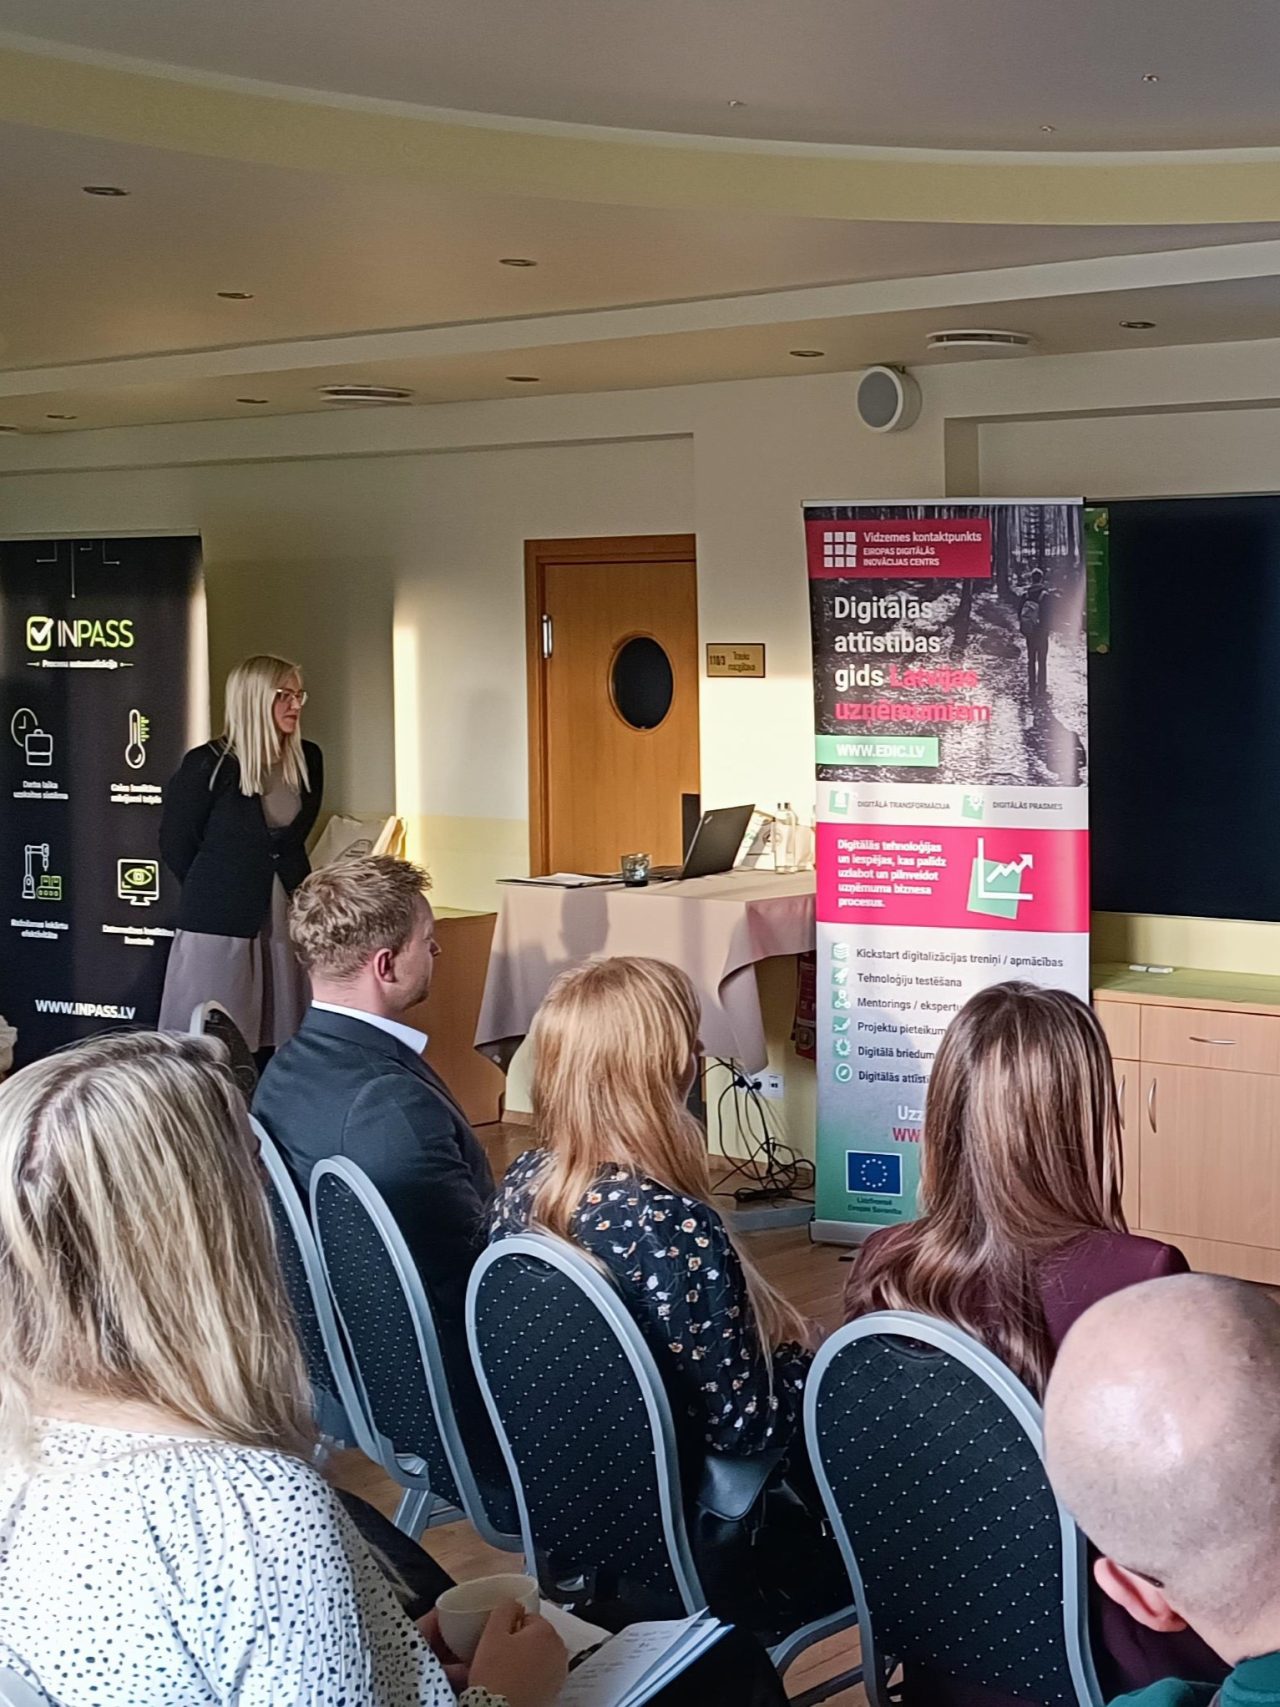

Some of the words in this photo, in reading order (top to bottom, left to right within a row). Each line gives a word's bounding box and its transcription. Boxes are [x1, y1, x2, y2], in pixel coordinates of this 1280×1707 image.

[863, 532, 911, 542] Vidzemes
[913, 531, 982, 544] kontaktpunkts
[863, 547, 895, 556] EIROPAS
[910, 558, 940, 567] CENTRS
[834, 596, 933, 623] Digitālās
[58, 619, 134, 648] INPASS
[834, 632, 941, 653] attīstības
[835, 664, 884, 691] gids
[889, 665, 980, 692] Latvijas
[835, 700, 992, 727] uzņēmumiem
[836, 743, 925, 758] WWW.EDIC.LV
[857, 948, 900, 960] Kickstart
[902, 950, 968, 965] digitalizācijas
[970, 954, 1001, 967] treniņi
[1003, 956, 1008, 966] /
[1010, 956, 1064, 968] apmācības
[857, 973, 913, 987] Tehnoloģiju
[916, 976, 962, 987] testēšana
[35, 999, 136, 1020] WWW.INPASS.LV
[857, 998, 911, 1012] Mentorings
[913, 1001, 918, 1010] /
[857, 1022, 897, 1034] Projektu
[858, 1046, 894, 1058] Digitālā
[858, 1070, 899, 1083] Digitālās
